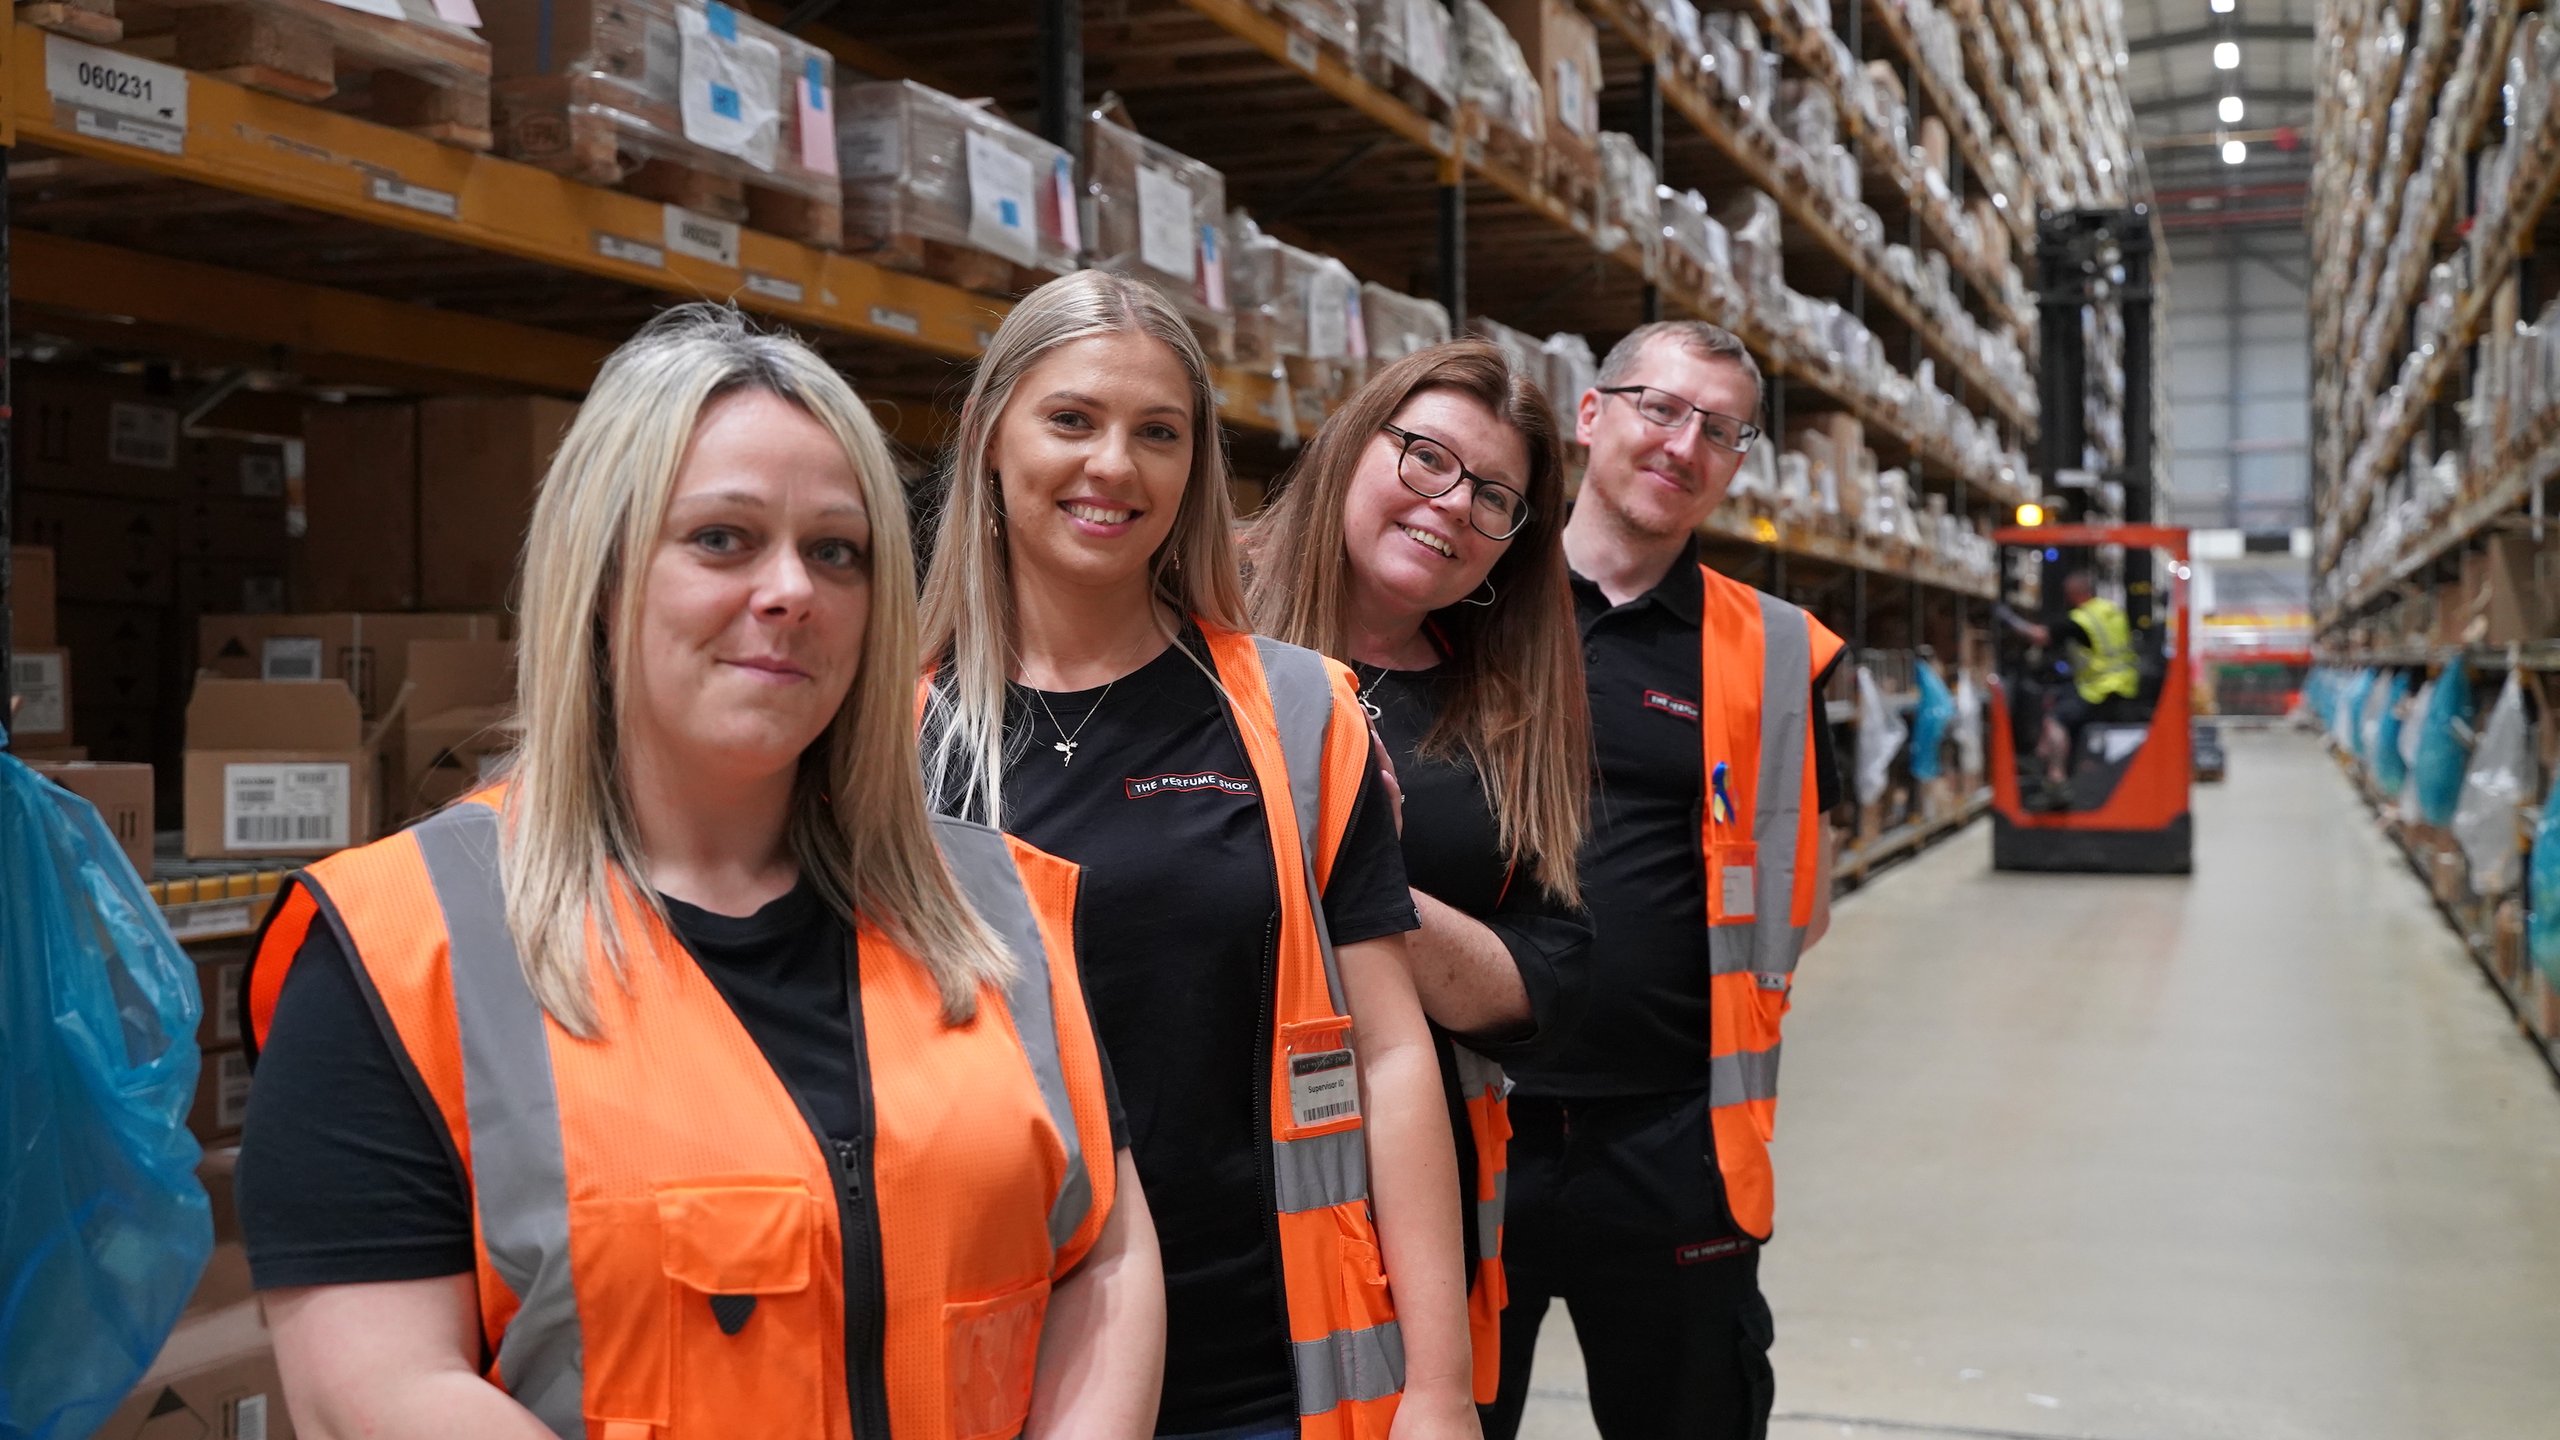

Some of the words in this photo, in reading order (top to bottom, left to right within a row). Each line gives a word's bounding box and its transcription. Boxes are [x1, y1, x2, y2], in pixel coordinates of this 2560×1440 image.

[78, 61, 152, 102] 060231
[1135, 781, 1158, 793] THE
[1162, 775, 1216, 787] PERFUME
[1218, 779, 1249, 791] SHOP
[1308, 1081, 1337, 1094] Supervisor
[1338, 1079, 1345, 1088] ID
